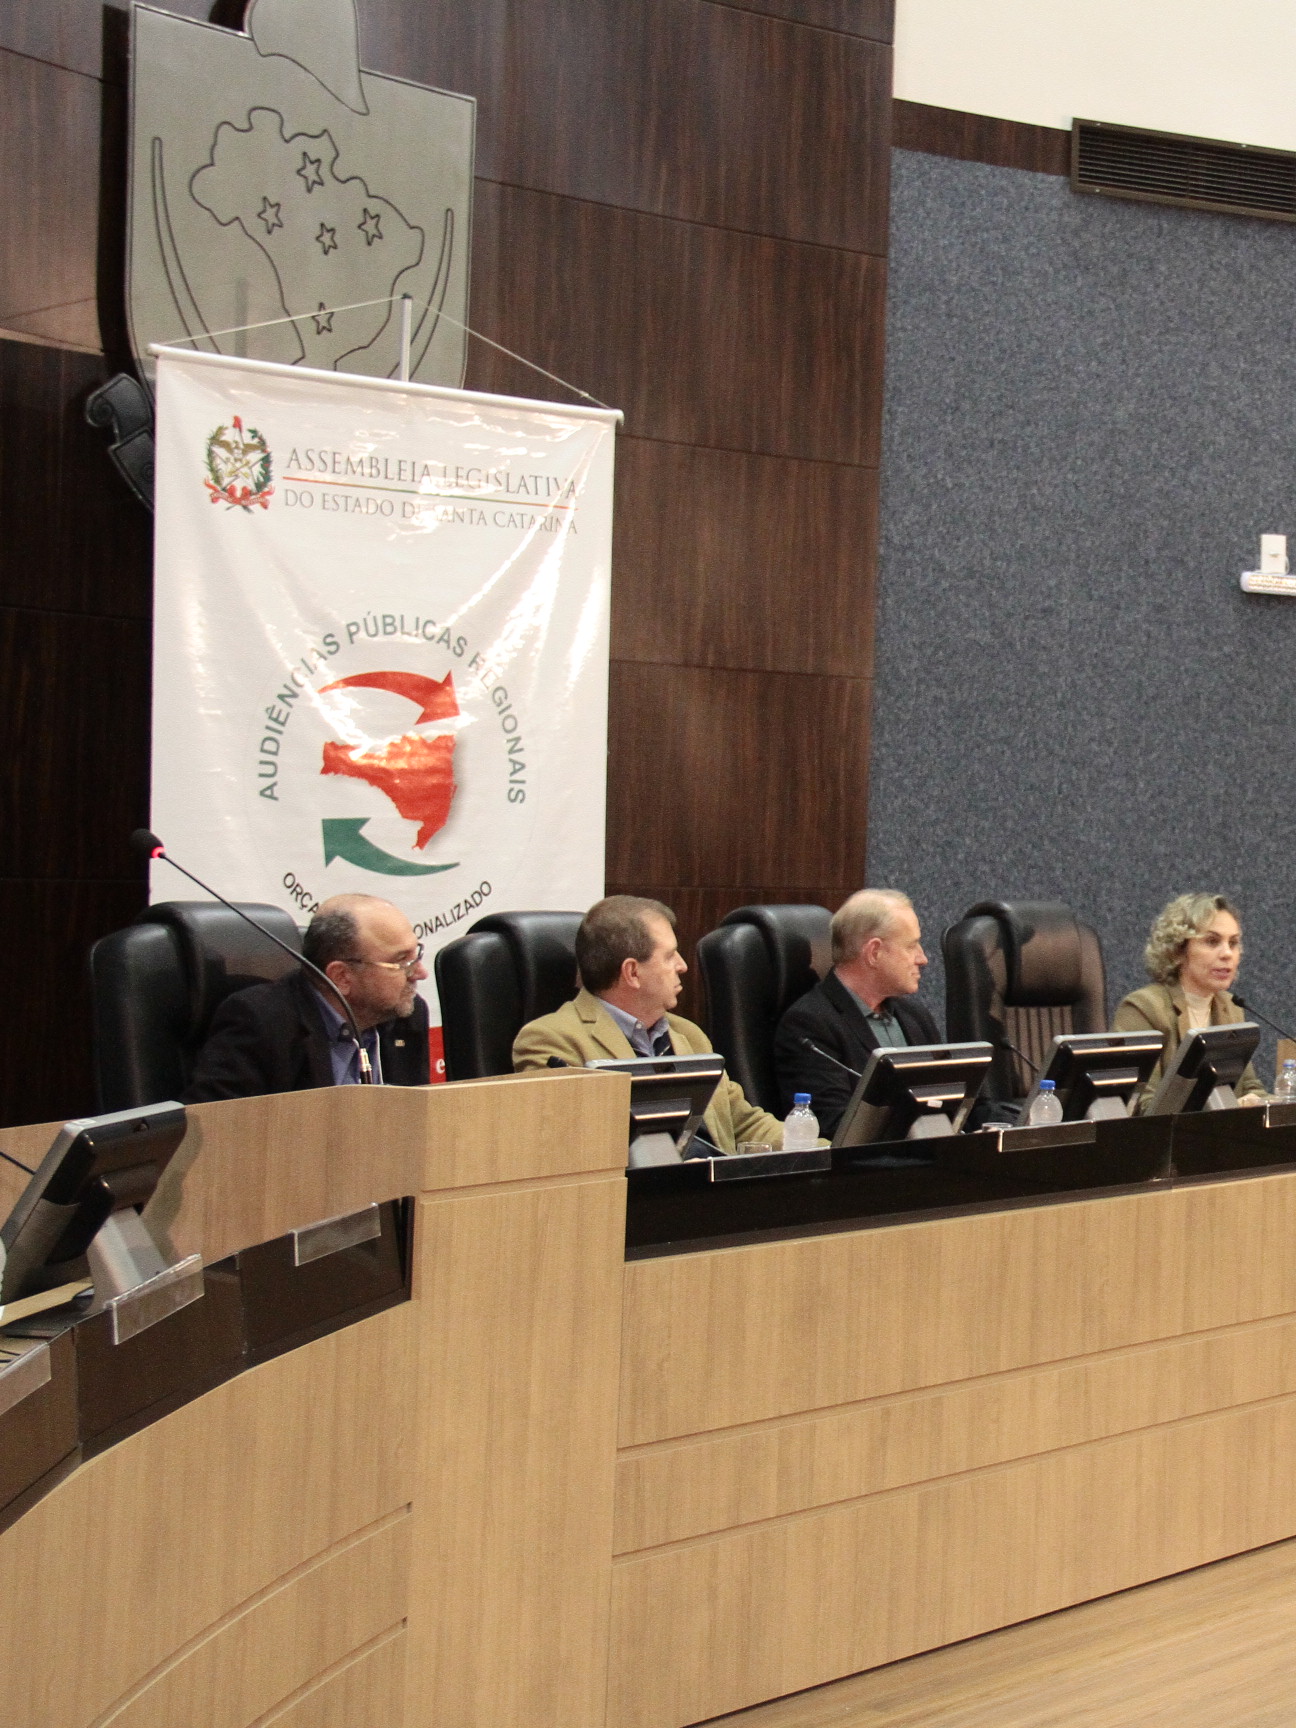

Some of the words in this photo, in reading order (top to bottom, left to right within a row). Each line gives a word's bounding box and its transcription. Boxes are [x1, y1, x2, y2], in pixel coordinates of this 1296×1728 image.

[286, 447, 431, 484] ASSEMBLEIA
[442, 464, 577, 499] LEGISLATIVA
[284, 488, 314, 508] DO
[321, 492, 395, 517] ESTADO
[493, 510, 578, 534] CATARINA
[258, 633, 341, 801] AUDIÊNCIAS
[345, 611, 468, 658] PÚBLICAS
[468, 652, 527, 804] REGIONAIS
[283, 872, 319, 914] ORÇA
[413, 881, 492, 940] ONALIZADO
